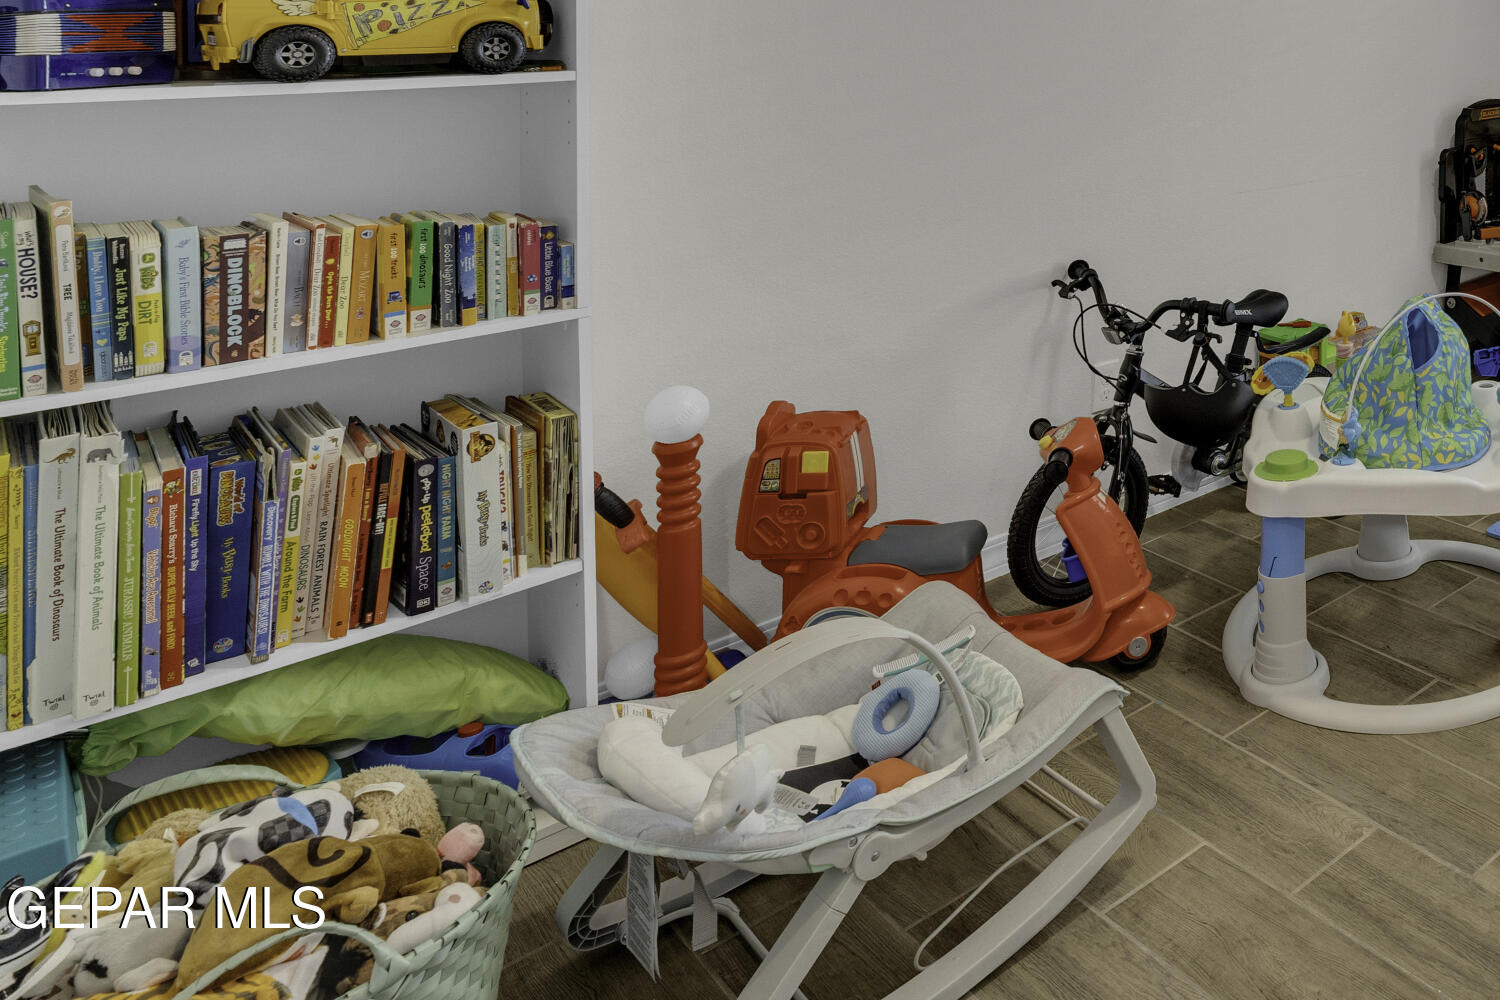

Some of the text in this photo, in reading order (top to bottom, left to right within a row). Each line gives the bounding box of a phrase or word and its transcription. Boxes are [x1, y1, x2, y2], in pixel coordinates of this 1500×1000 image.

[420, 228, 429, 242] first
[444, 244, 453, 262] Good
[544, 242, 553, 292] Little Blue Boat
[18, 247, 38, 299] HOUSE?
[178, 257, 190, 280] Baby's
[391, 260, 399, 279] trucks
[418, 255, 428, 288] dinosaurs
[442, 265, 453, 286] Night
[63, 283, 72, 301] TREE
[94, 280, 104, 296] Love
[179, 282, 190, 298] First
[312, 285, 320, 297] Zoo
[340, 276, 348, 294] Dear
[357, 270, 370, 302] MOZART
[445, 289, 453, 304] Zoo
[95, 298, 106, 312] You
[114, 268, 130, 341] Just Like My Papa
[138, 300, 152, 326] DIRT
[180, 300, 190, 318] Bible
[226, 257, 243, 347] DINOBLOCK
[180, 320, 192, 346] Stories
[217, 471, 235, 526] DINOSAURS
[441, 464, 452, 540] NIGHT NIGHT FARM
[54, 508, 66, 524] The
[94, 506, 106, 522] The
[168, 504, 178, 533] Richard
[264, 506, 276, 541] Discovery
[374, 503, 387, 535] FACE-OFF!
[52, 526, 65, 562] Ultimate
[93, 523, 106, 560] Ultimate
[188, 520, 199, 572] Light Up the Sky
[310, 462, 335, 613] Ultimate Spotlight RAIN FOREST ANIMALS
[416, 478, 433, 591] pop-up peekaboo! Space
[166, 535, 177, 564] Scarry's
[220, 549, 237, 574] Busy
[338, 518, 354, 588] GOODNIGHT MOON
[52, 564, 64, 587] Book
[92, 562, 104, 584] Book
[280, 541, 296, 613] Around the Farm
[296, 544, 311, 591] DINOSAURS
[50, 589, 64, 598] of
[90, 586, 104, 595] of
[122, 576, 134, 620] JURASSIC
[51, 600, 64, 642] Dinosaurs
[91, 597, 104, 631] Animals
[122, 622, 134, 661] ANIMALS
